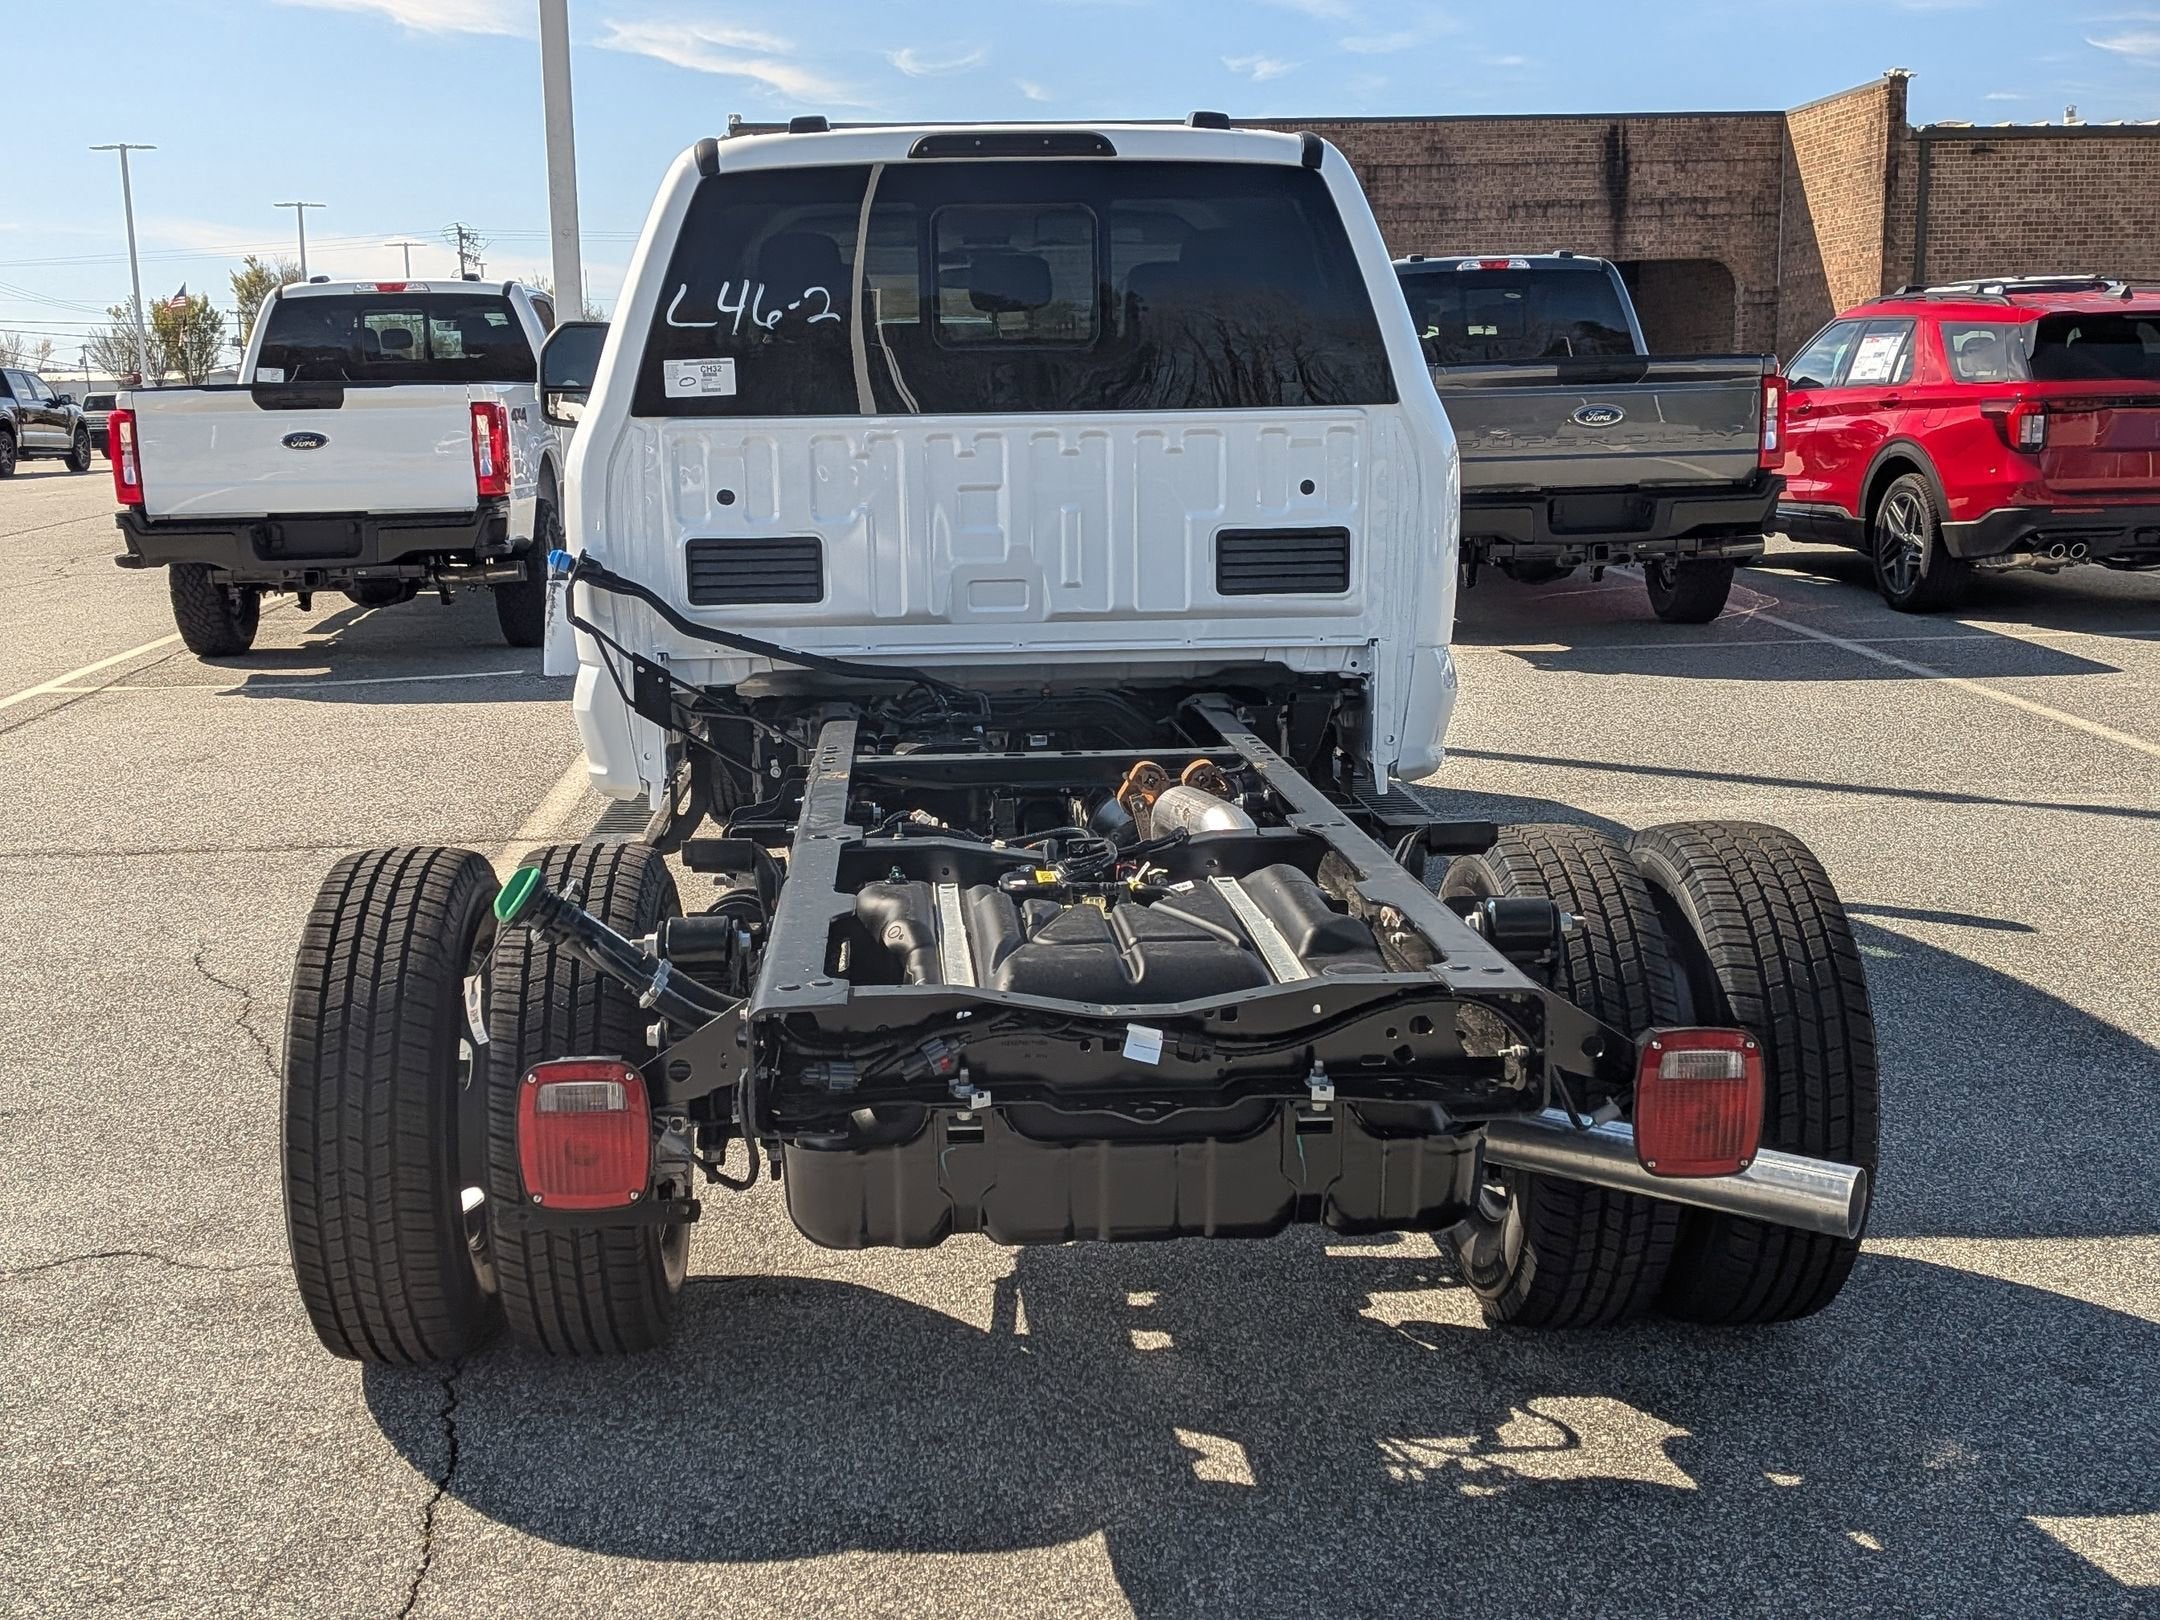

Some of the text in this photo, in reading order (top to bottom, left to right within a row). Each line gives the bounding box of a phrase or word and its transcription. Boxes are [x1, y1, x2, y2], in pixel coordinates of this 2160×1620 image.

[700, 365, 722, 373] CH32
[1586, 410, 1612, 422] Ford
[291, 435, 318, 448] Ford
[1623, 430, 1742, 446] DUTY
